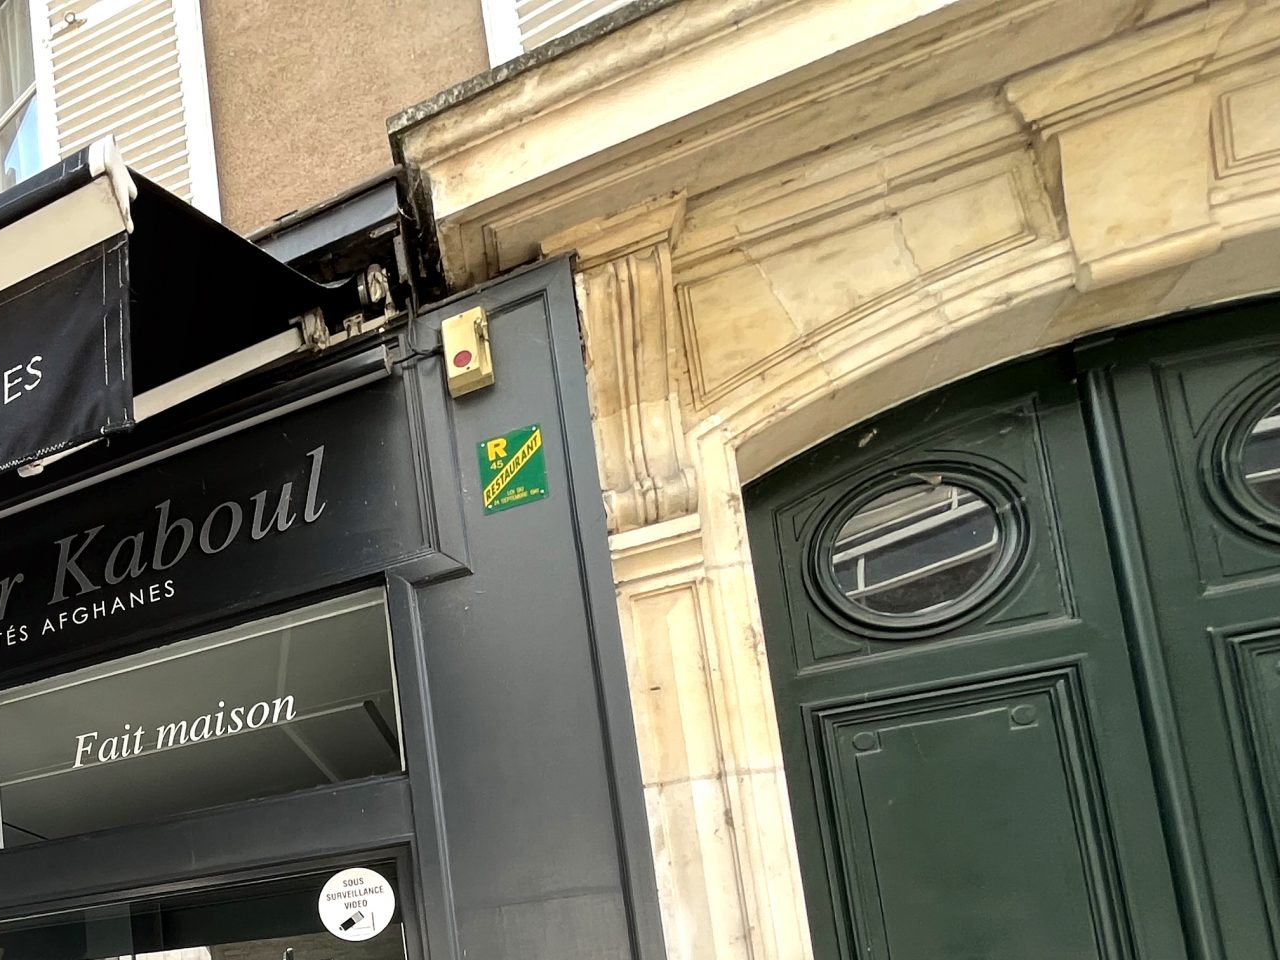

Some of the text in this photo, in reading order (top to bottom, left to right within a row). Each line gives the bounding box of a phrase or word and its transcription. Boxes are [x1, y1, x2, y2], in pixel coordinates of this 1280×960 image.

[485, 435, 538, 502] RESTAURANT
[486, 437, 508, 462] R
[489, 459, 504, 470] 45
[47, 444, 327, 606] Kaboul
[40, 579, 176, 636] AFGHANES
[73, 694, 297, 769] Fait maison
[325, 885, 384, 902] SURVEILLANCE
[342, 877, 365, 888] SOUS
